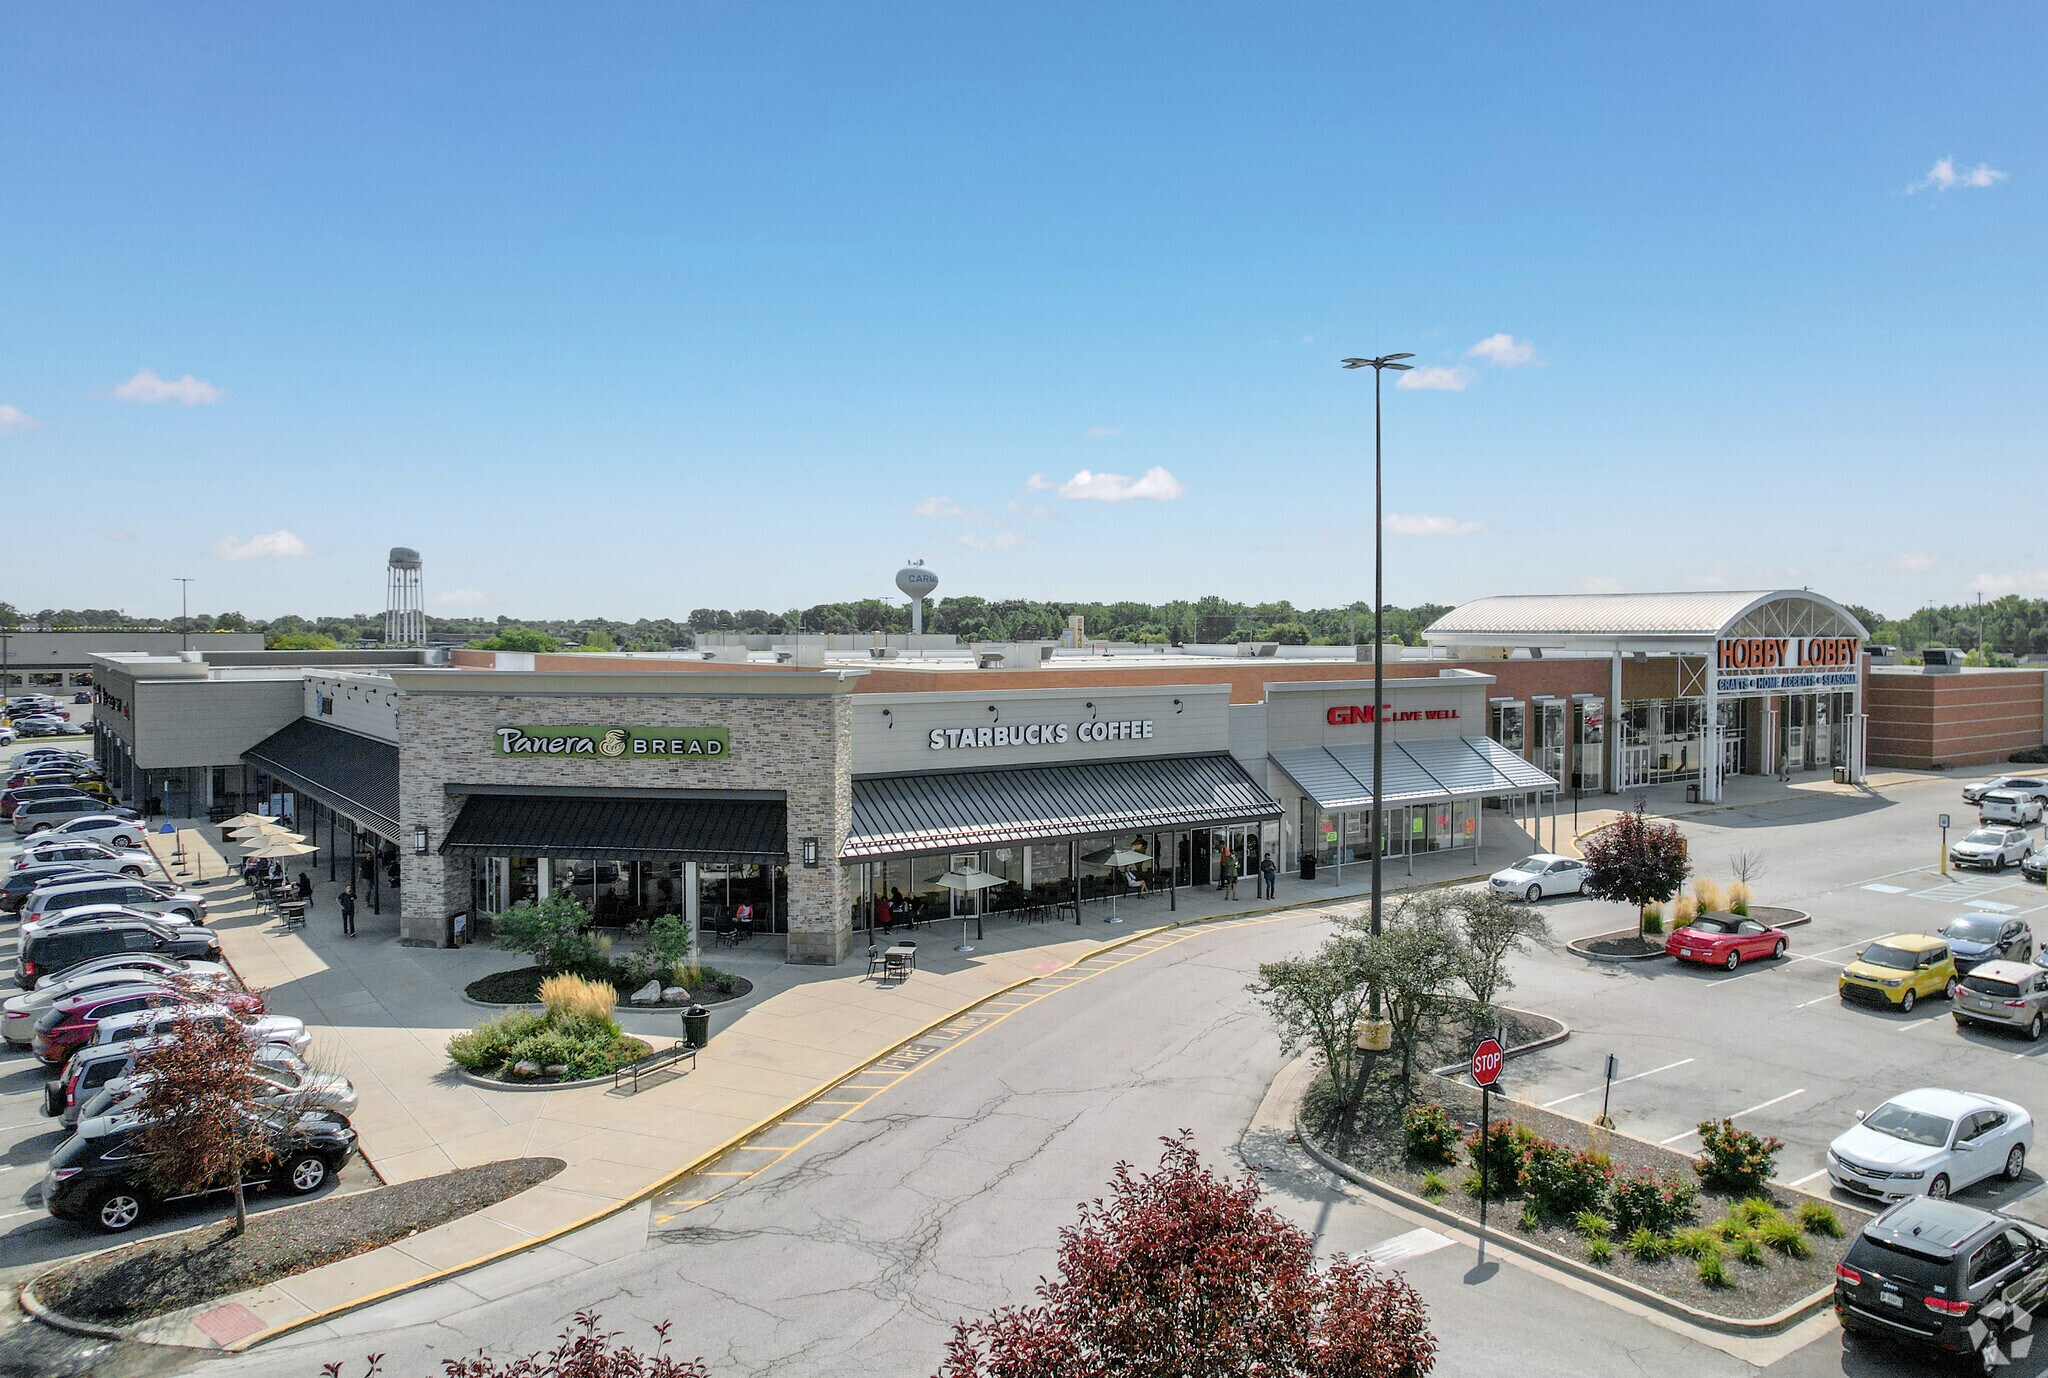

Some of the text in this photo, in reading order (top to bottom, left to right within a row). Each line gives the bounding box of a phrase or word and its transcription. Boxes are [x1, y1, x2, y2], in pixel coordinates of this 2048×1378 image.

[1717, 638, 1859, 669] HOBBY LOBBY
[1756, 675, 1780, 689] HOME
[1781, 674, 1816, 688] ACCENTS
[1393, 711, 1422, 721] LIVE
[1425, 709, 1460, 720] WELL
[496, 728, 724, 755] Panera BREAD
[929, 720, 1154, 750] STARBUCKS COFFEE
[1475, 1052, 1500, 1073] STOP
